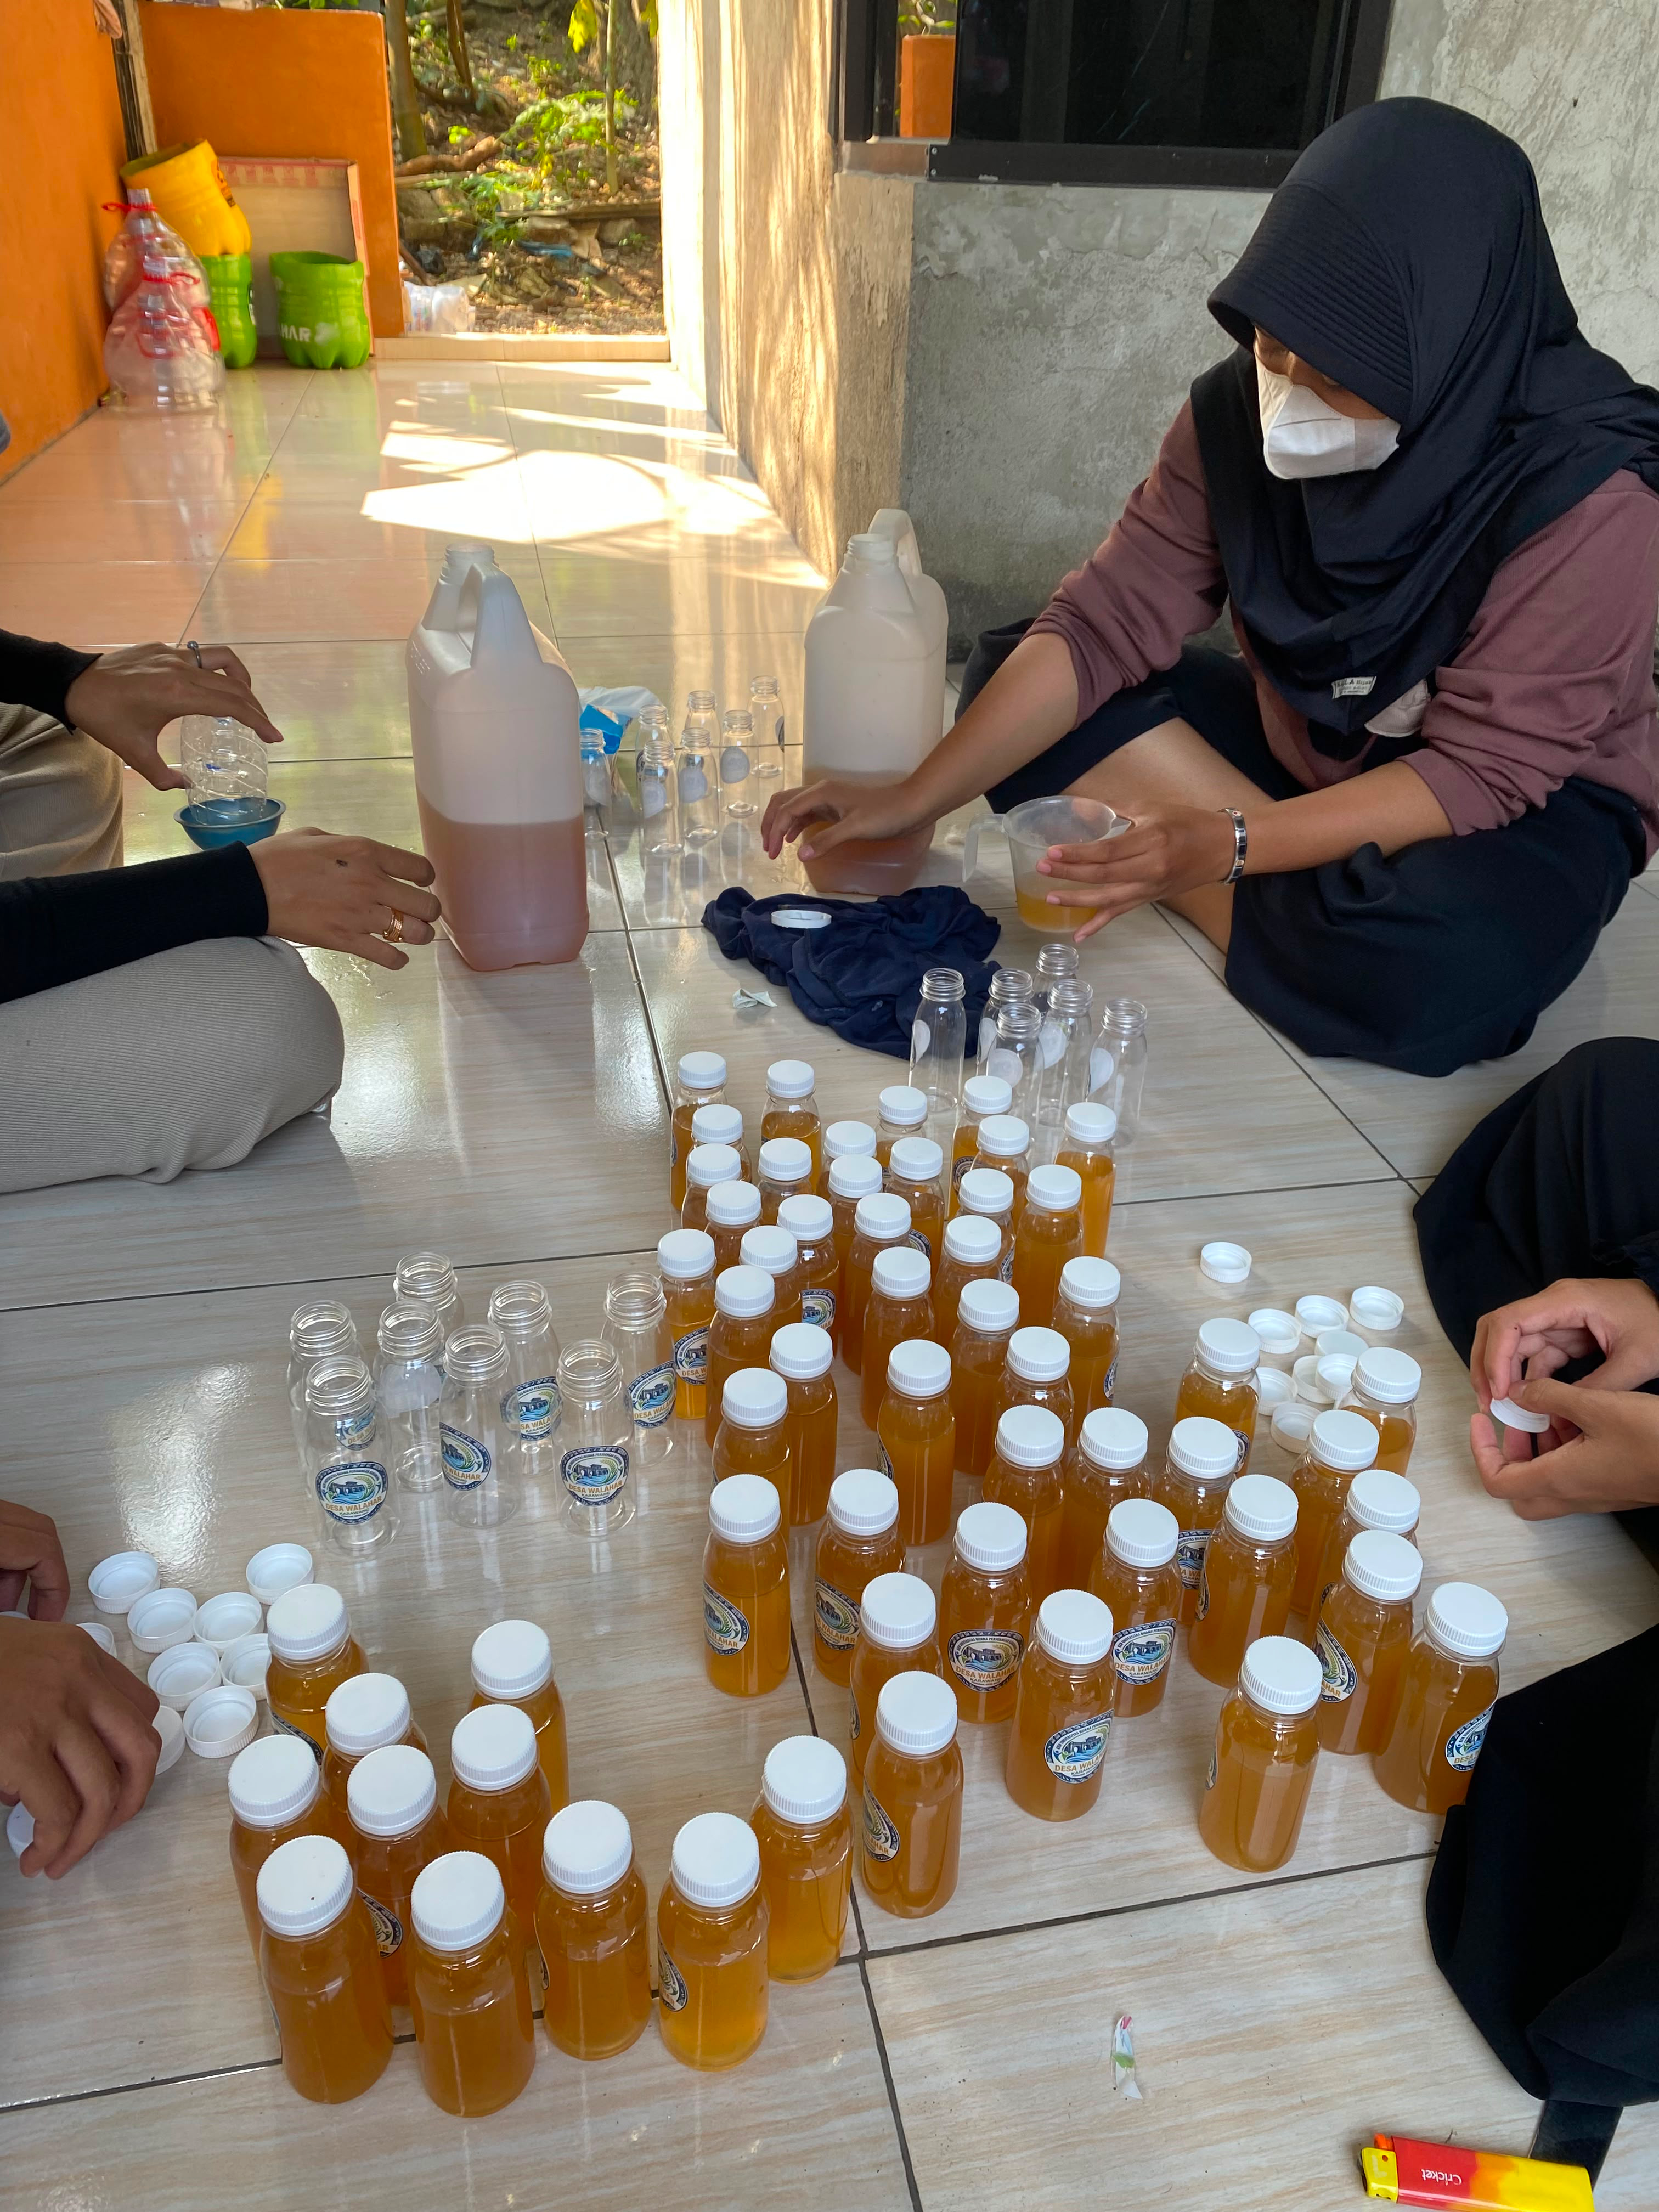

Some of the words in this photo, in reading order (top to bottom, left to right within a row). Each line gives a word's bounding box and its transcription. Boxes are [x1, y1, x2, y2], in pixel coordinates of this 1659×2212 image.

[531, 1417, 551, 1427] WALA
[448, 1467, 481, 1480] WALAHAR
[568, 1483, 586, 1493] DESA
[588, 1480, 622, 1493] WALAHAR
[326, 1503, 344, 1511] DESA
[345, 1496, 382, 1511] WALAHAR
[956, 1666, 975, 1678] DESA
[978, 1666, 1015, 1679] WALAHAR
[1115, 1663, 1135, 1672] DESA
[1322, 1681, 1341, 1697] AHAR
[1454, 1753, 1474, 1764] DESA
[1420, 2169, 1462, 2186] Cricket
